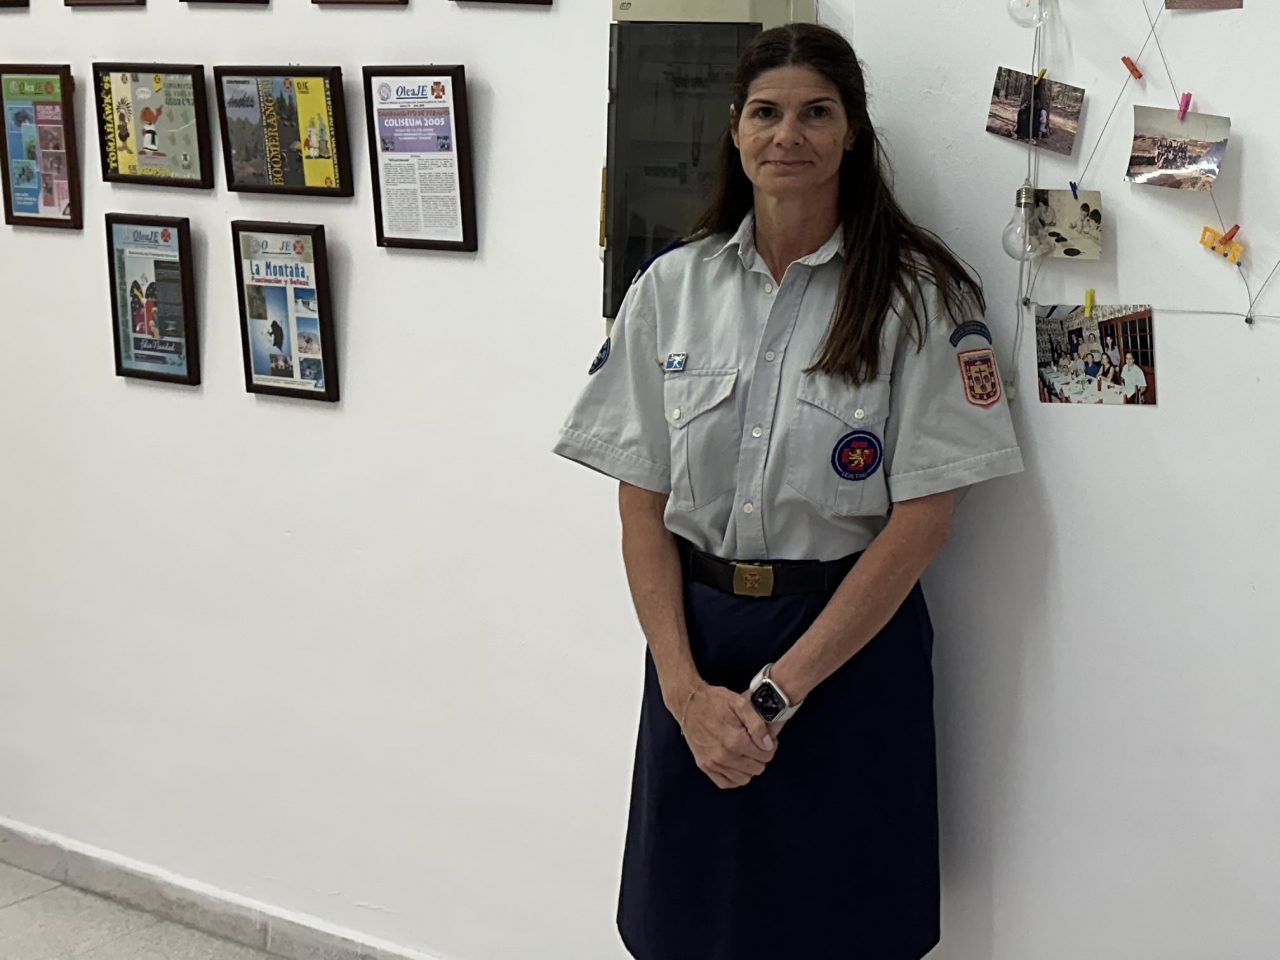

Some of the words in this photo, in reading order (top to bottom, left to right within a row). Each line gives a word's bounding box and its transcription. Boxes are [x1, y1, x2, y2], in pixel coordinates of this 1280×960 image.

[396, 85, 428, 97] OleaJE
[384, 118, 422, 127] COLISEUM
[423, 117, 445, 126] 2005
[103, 95, 118, 169] TOMAHAWK
[263, 95, 284, 186] BOOMERANG
[250, 259, 260, 276] La
[265, 260, 309, 280] Montaña,
[251, 275, 282, 285] Fascinación
